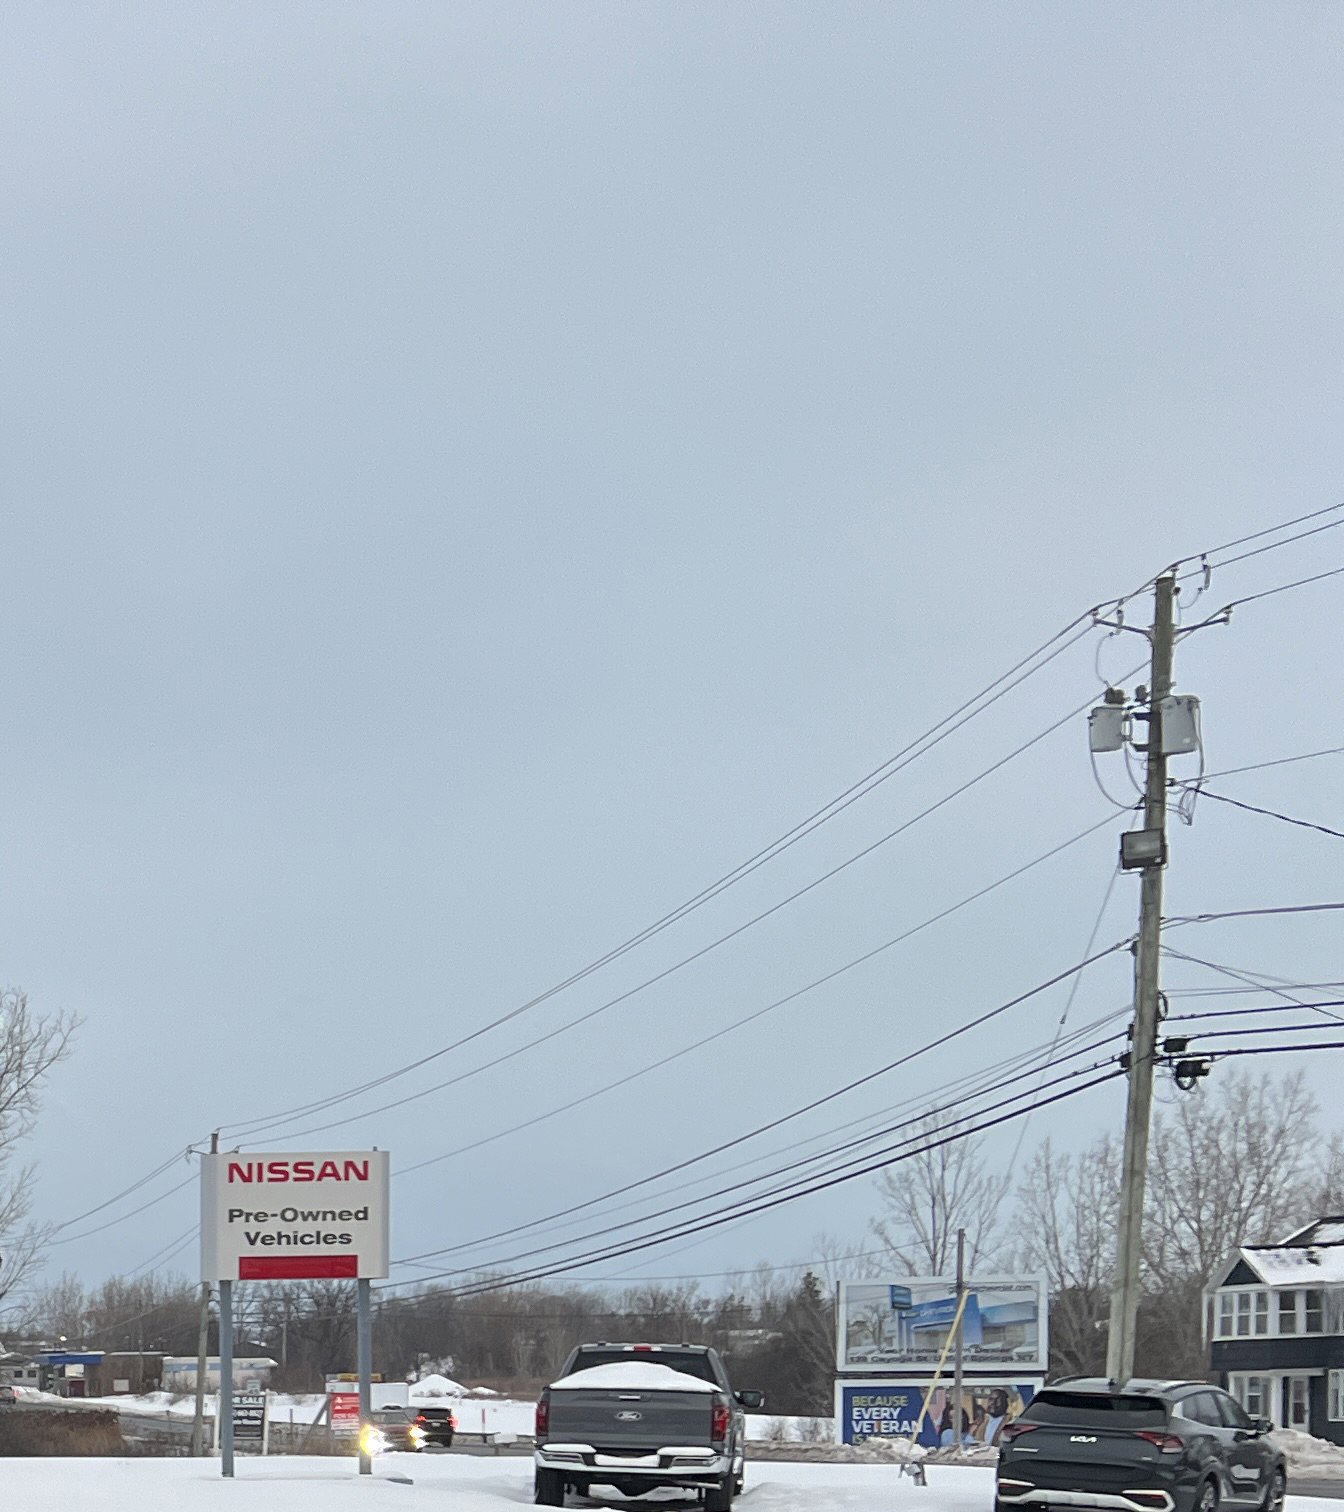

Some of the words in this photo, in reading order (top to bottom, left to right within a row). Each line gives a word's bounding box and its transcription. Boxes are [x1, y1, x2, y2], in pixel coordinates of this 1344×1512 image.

[227, 1160, 370, 1184] NISSAN
[227, 1206, 370, 1223] Pre-Owned
[244, 1230, 353, 1247] Vehicles
[852, 1395, 909, 1407] BECAUSE
[852, 1407, 902, 1420] EVERY
[852, 1420, 924, 1433] VETERAN
